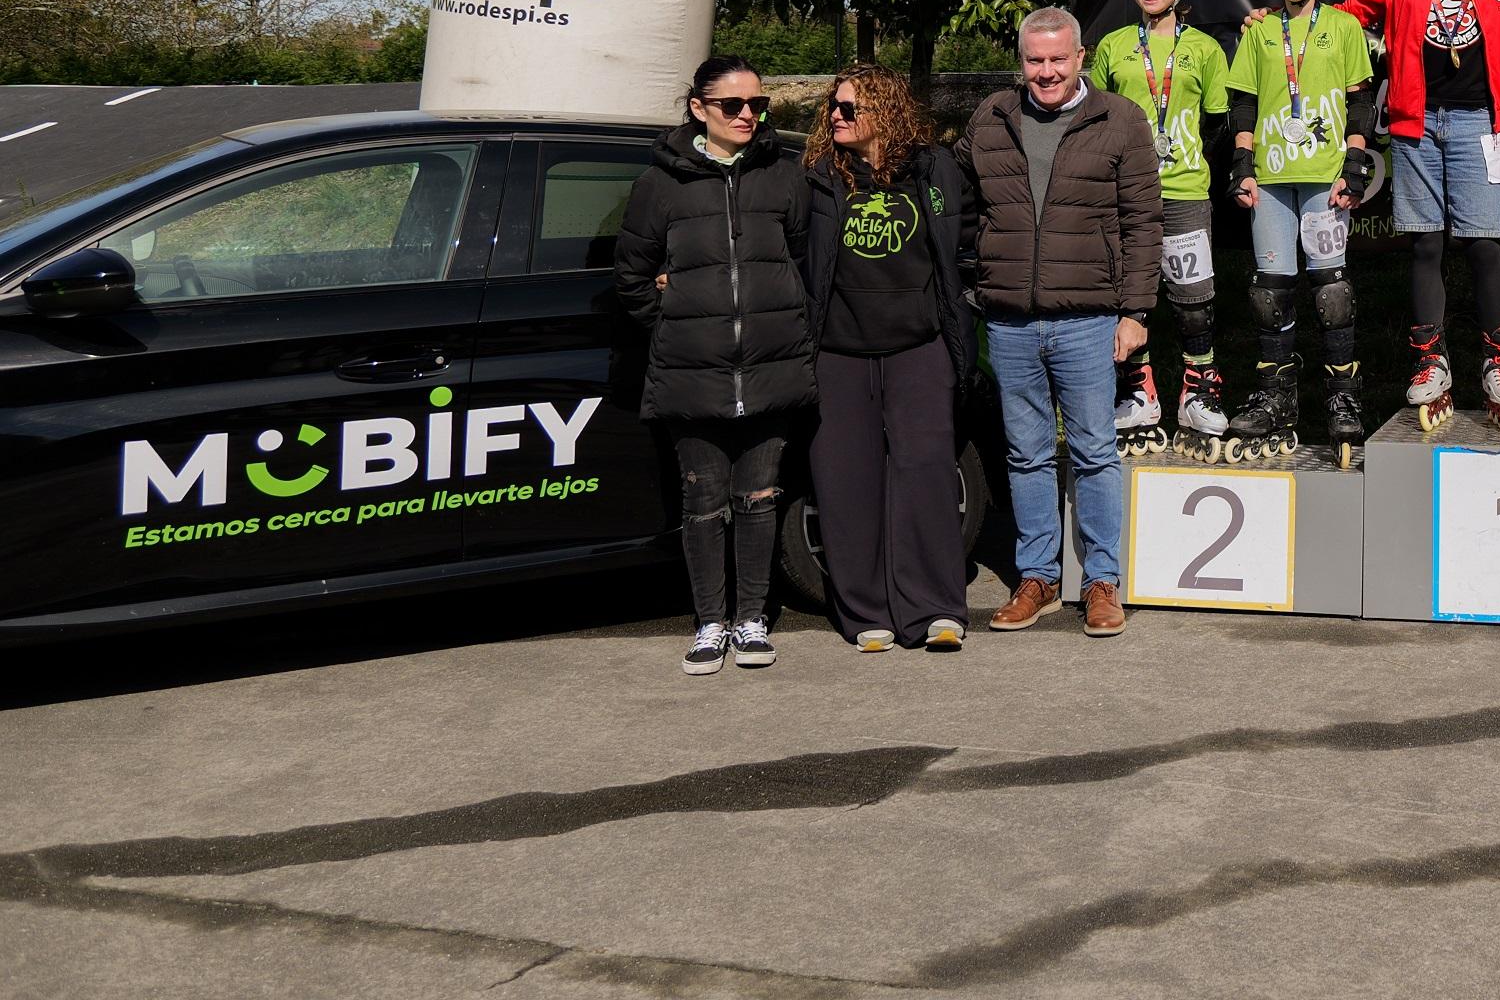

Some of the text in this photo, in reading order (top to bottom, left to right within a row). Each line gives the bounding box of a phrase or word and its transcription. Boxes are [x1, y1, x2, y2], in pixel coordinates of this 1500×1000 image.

[1168, 252, 1200, 280] 92
[1316, 224, 1346, 255] 89
[124, 474, 600, 549] Estamos cerca para llevarte lejos
[1177, 485, 1245, 591] 2
